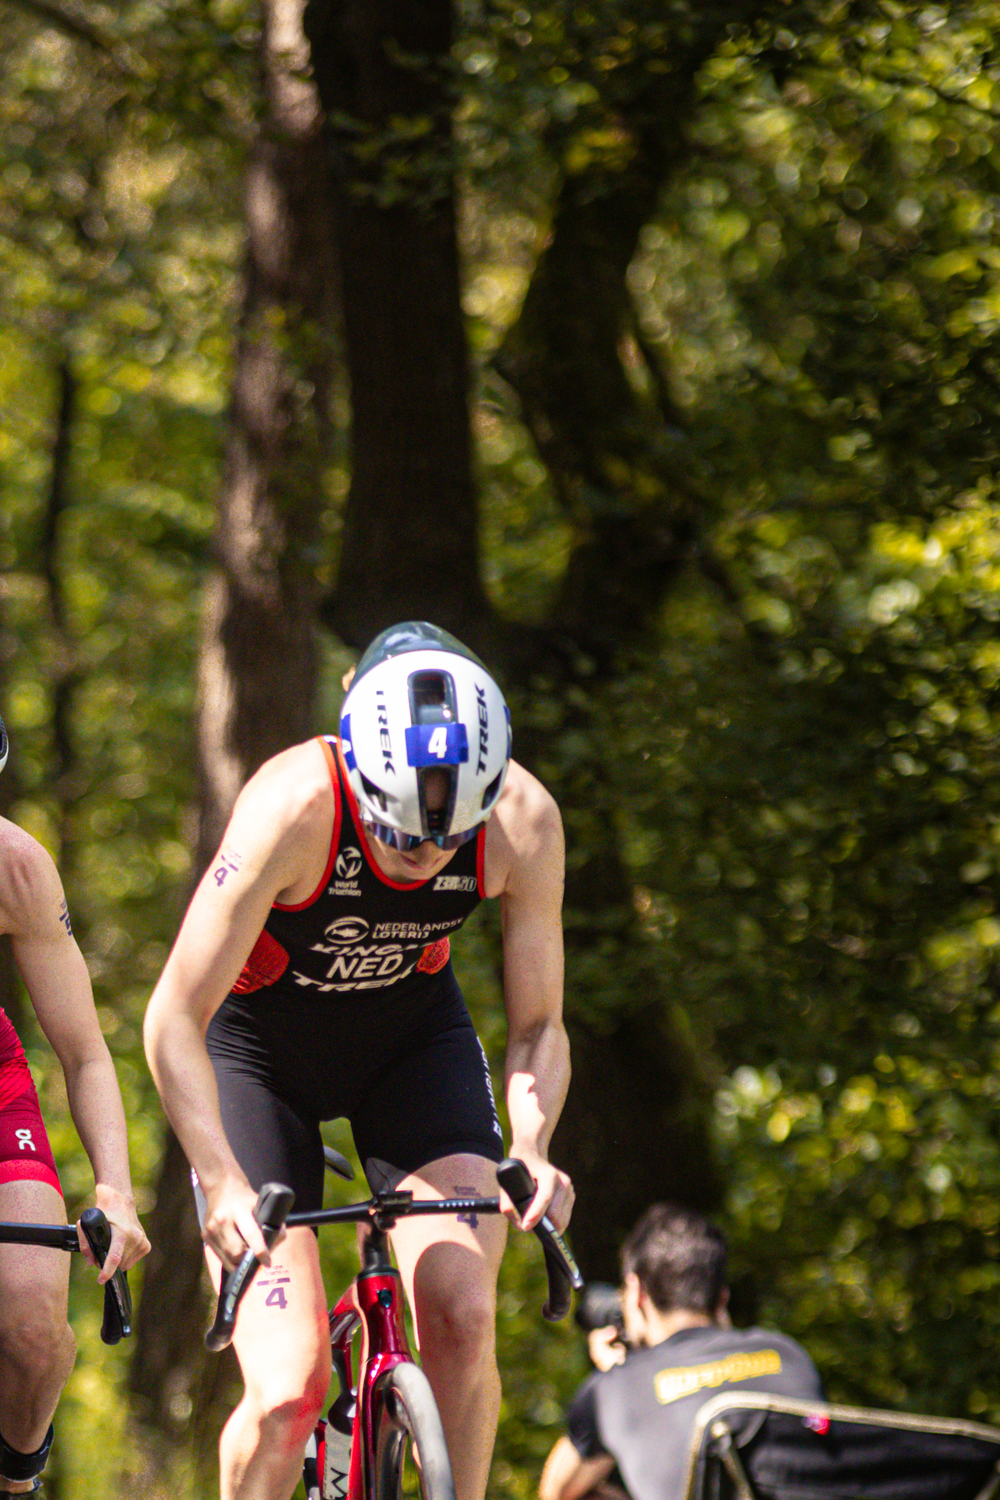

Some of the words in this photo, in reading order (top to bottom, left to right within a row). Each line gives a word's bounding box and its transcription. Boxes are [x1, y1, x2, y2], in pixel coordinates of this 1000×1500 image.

[474, 682, 489, 776] TREK
[428, 727, 447, 758] 4
[213, 866, 229, 888] 4
[372, 930, 430, 939] LOTERIJ
[326, 953, 404, 980] NED
[265, 1286, 288, 1310] 4
